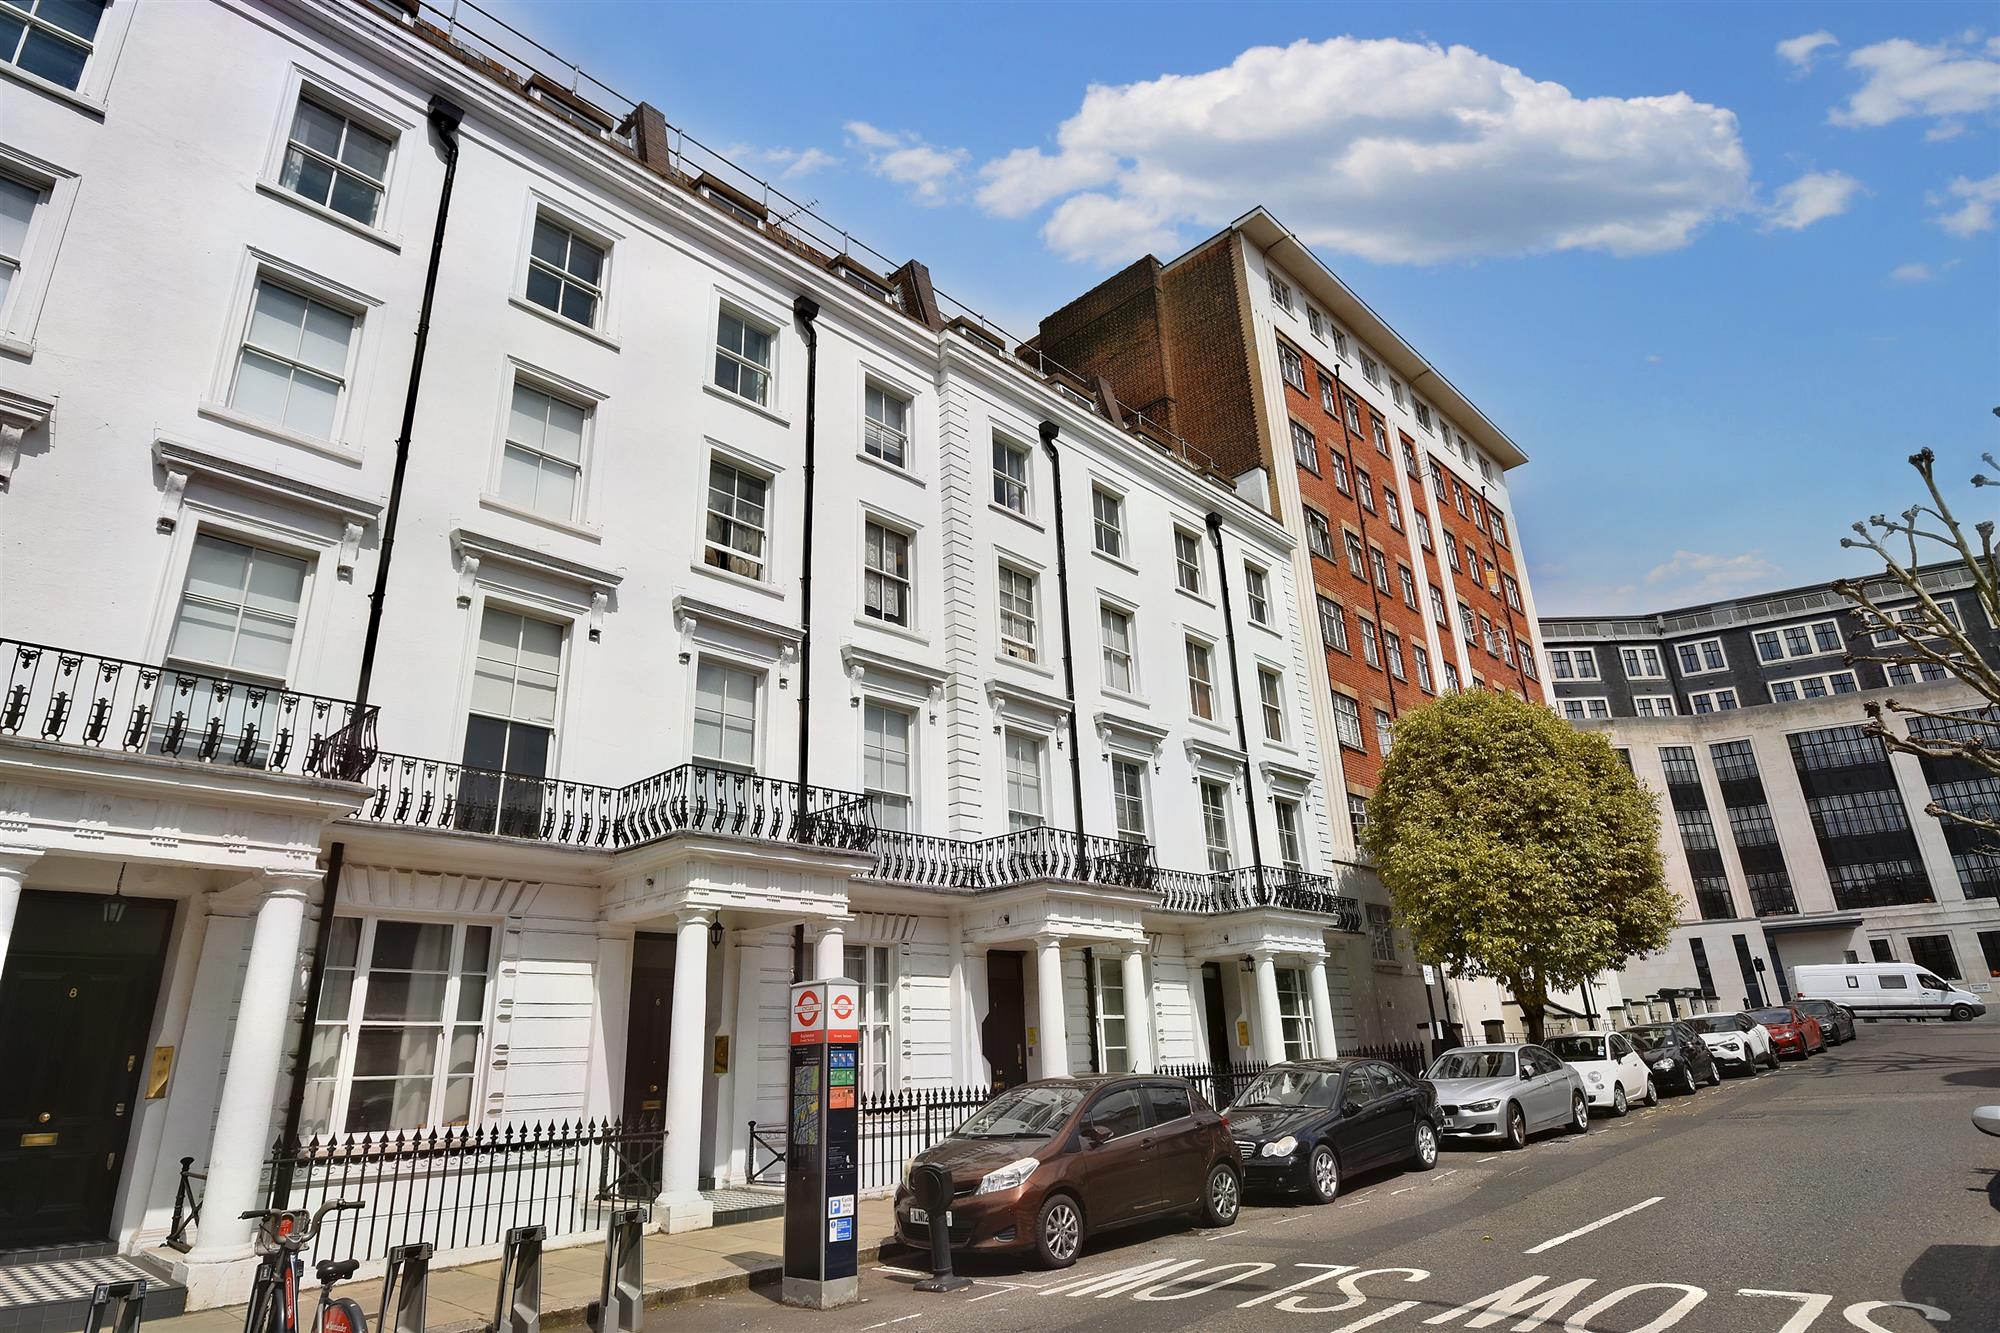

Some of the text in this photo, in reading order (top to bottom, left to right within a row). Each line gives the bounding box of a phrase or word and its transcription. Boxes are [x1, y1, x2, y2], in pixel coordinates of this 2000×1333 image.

[69, 987, 78, 998] 8
[655, 998, 661, 1006] 6
[831, 1201, 839, 1214] P
[1038, 1258, 1430, 1313] SLOW
